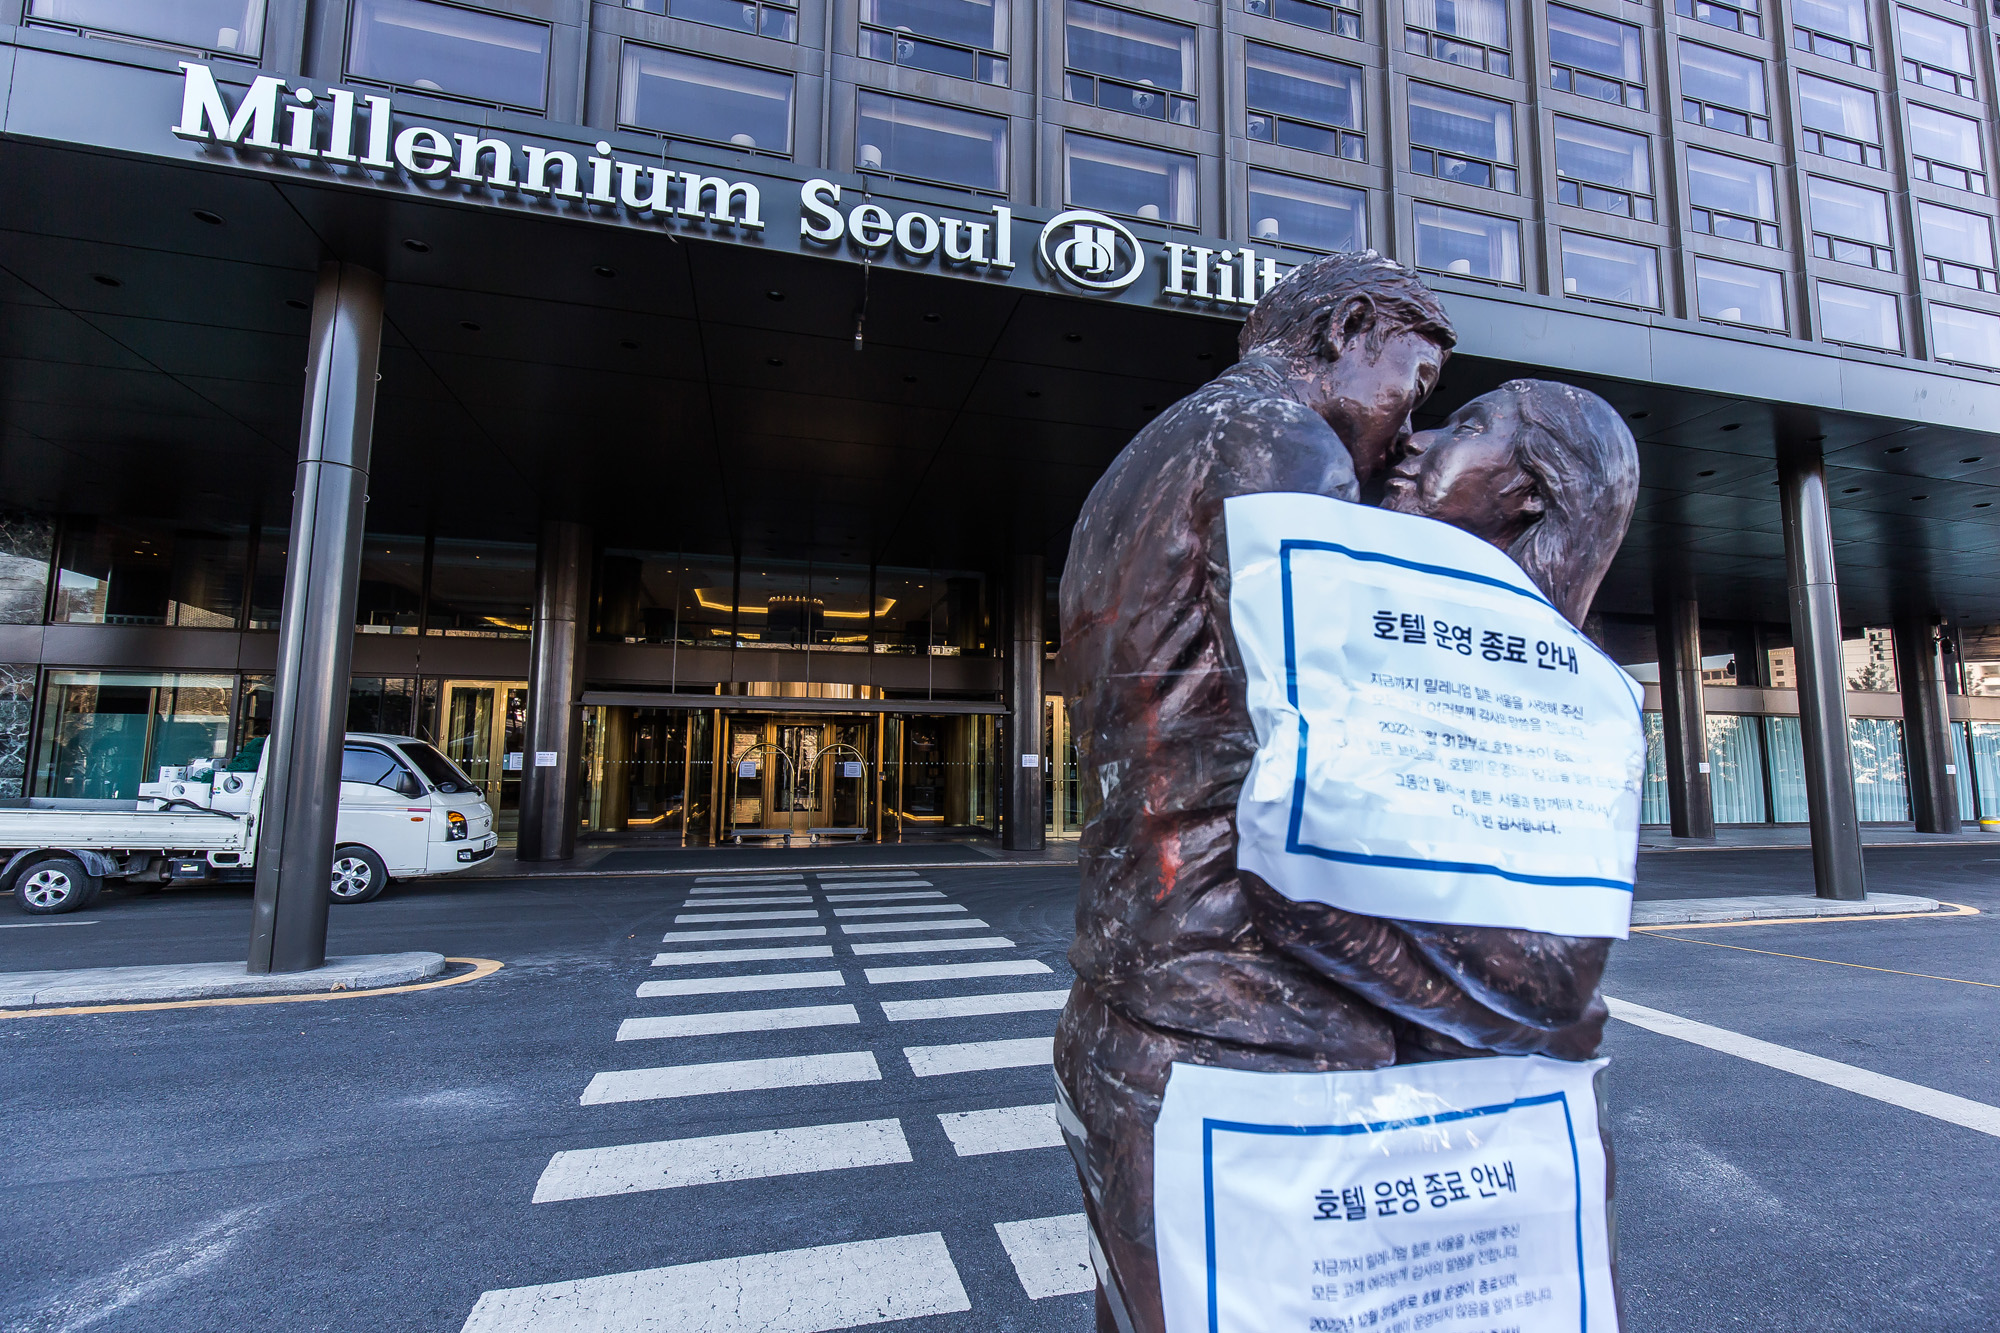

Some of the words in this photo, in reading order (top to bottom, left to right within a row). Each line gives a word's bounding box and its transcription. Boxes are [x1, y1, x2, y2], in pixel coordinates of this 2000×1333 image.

[171, 60, 766, 232] Millennium
[800, 178, 1016, 270] Seoul
[1162, 241, 1283, 305] Hilt
[1373, 611, 1427, 644] 호텔
[1433, 620, 1472, 656] 운영
[1480, 629, 1528, 664] 종료
[1535, 640, 1579, 674] 안내
[1371, 672, 1419, 692] 지금까지
[1424, 678, 1472, 699] 밀레니엄
[1496, 693, 1523, 710] 서울을
[1528, 699, 1558, 716] 사랑해
[1560, 703, 1584, 720] 주신
[1497, 816, 1562, 834] 감사합니다.
[1313, 1185, 1367, 1222] 호텔
[1374, 1176, 1420, 1217] 운영
[1423, 1171, 1470, 1209] 종료
[1470, 1160, 1517, 1199] 안내
[1312, 1257, 1363, 1277] 지금까지
[1365, 1246, 1408, 1270] 밀레니엄
[1411, 1240, 1431, 1259] 힐튼
[1436, 1233, 1465, 1252] 서울을
[1500, 1223, 1521, 1239] 주신
[1311, 1284, 1338, 1302] 모든
[1343, 1279, 1365, 1298] 고객
[1367, 1266, 1408, 1290] 여러분께
[1411, 1260, 1443, 1281] 감사의
